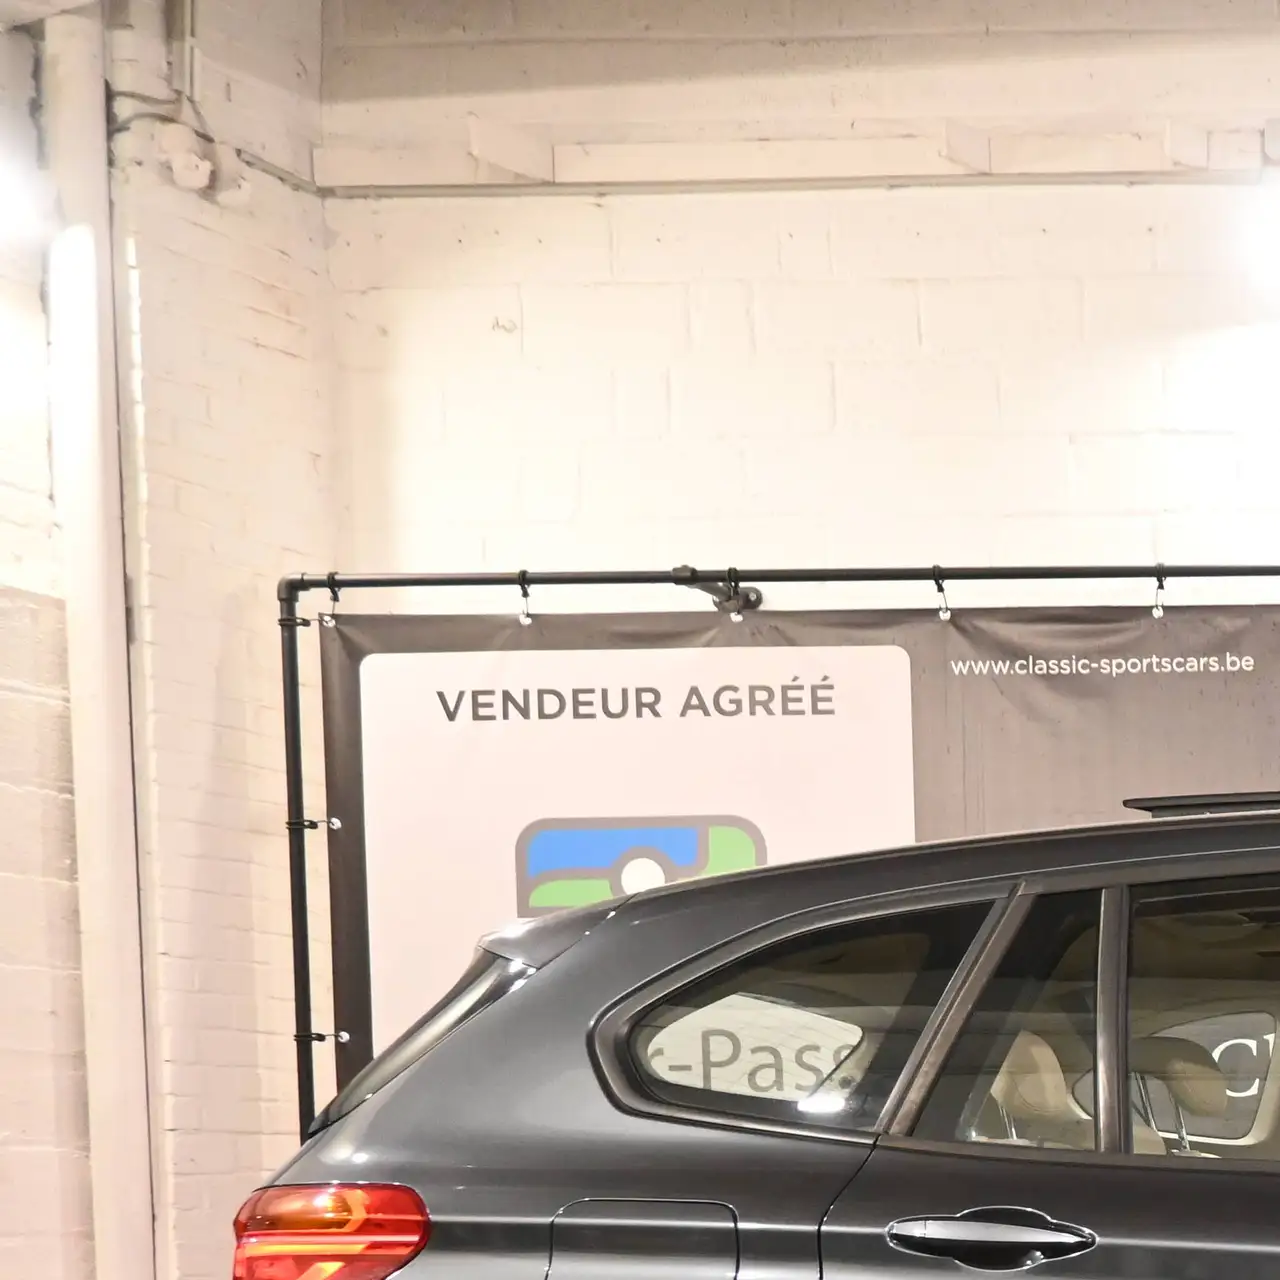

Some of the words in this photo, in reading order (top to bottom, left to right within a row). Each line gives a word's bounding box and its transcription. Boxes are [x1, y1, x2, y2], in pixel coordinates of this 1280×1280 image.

[950, 651, 1255, 678] www.classic-sportscars.be
[435, 686, 662, 723] VENDEUR
[679, 674, 836, 718] AGRÉÉ
